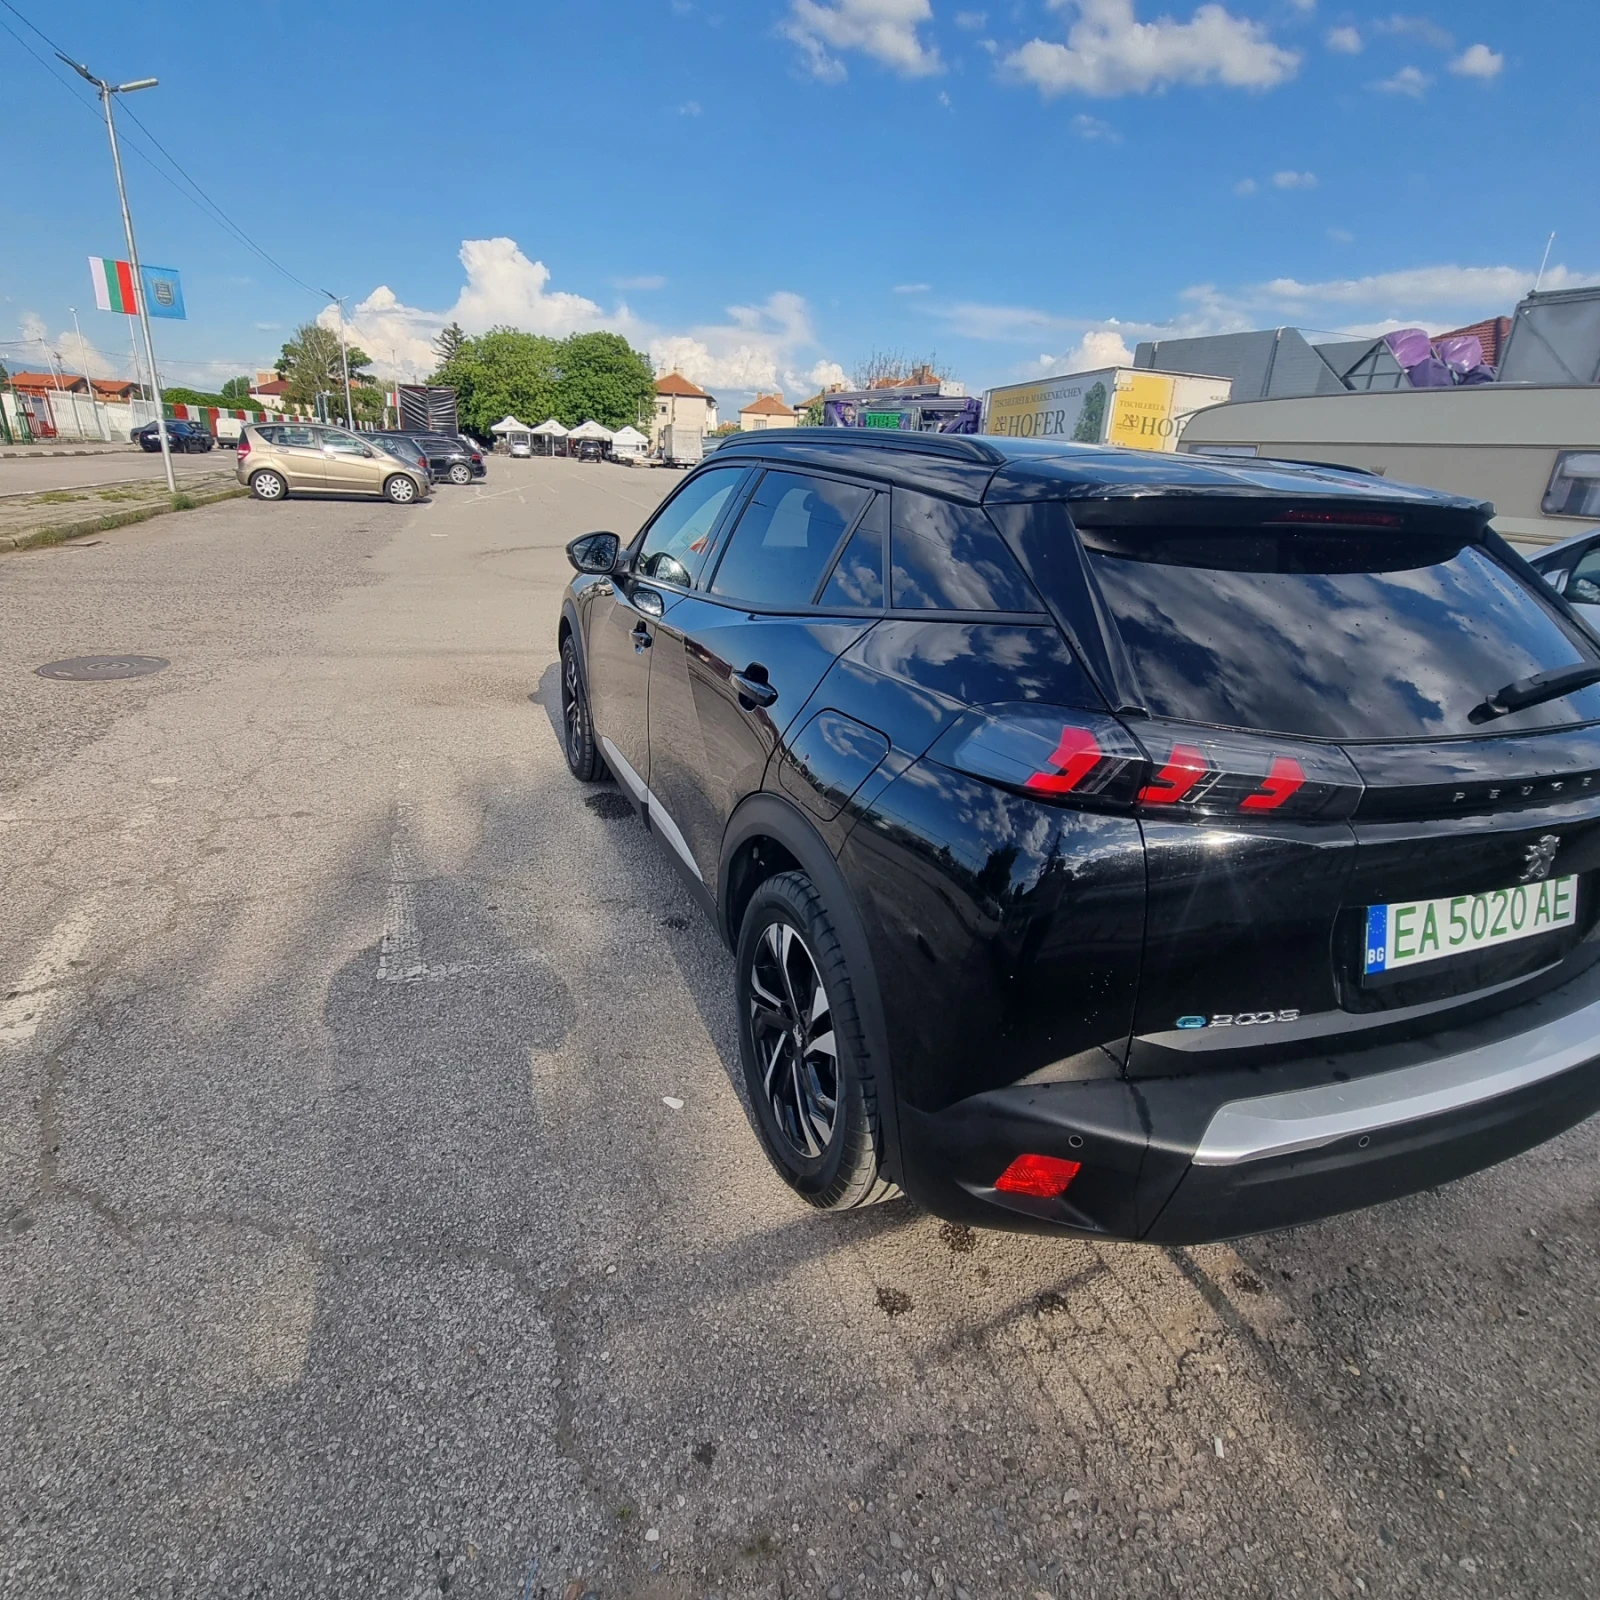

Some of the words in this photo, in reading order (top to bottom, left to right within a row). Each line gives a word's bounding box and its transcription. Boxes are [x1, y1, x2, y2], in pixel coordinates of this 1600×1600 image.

[1119, 400, 1160, 411] TISCHLEREI
[1008, 409, 1066, 437] HOFER
[1394, 902, 1440, 959] EA
[1449, 886, 1527, 945] 5020
[1534, 875, 1572, 927] AE
[1367, 947, 1385, 964] BG
